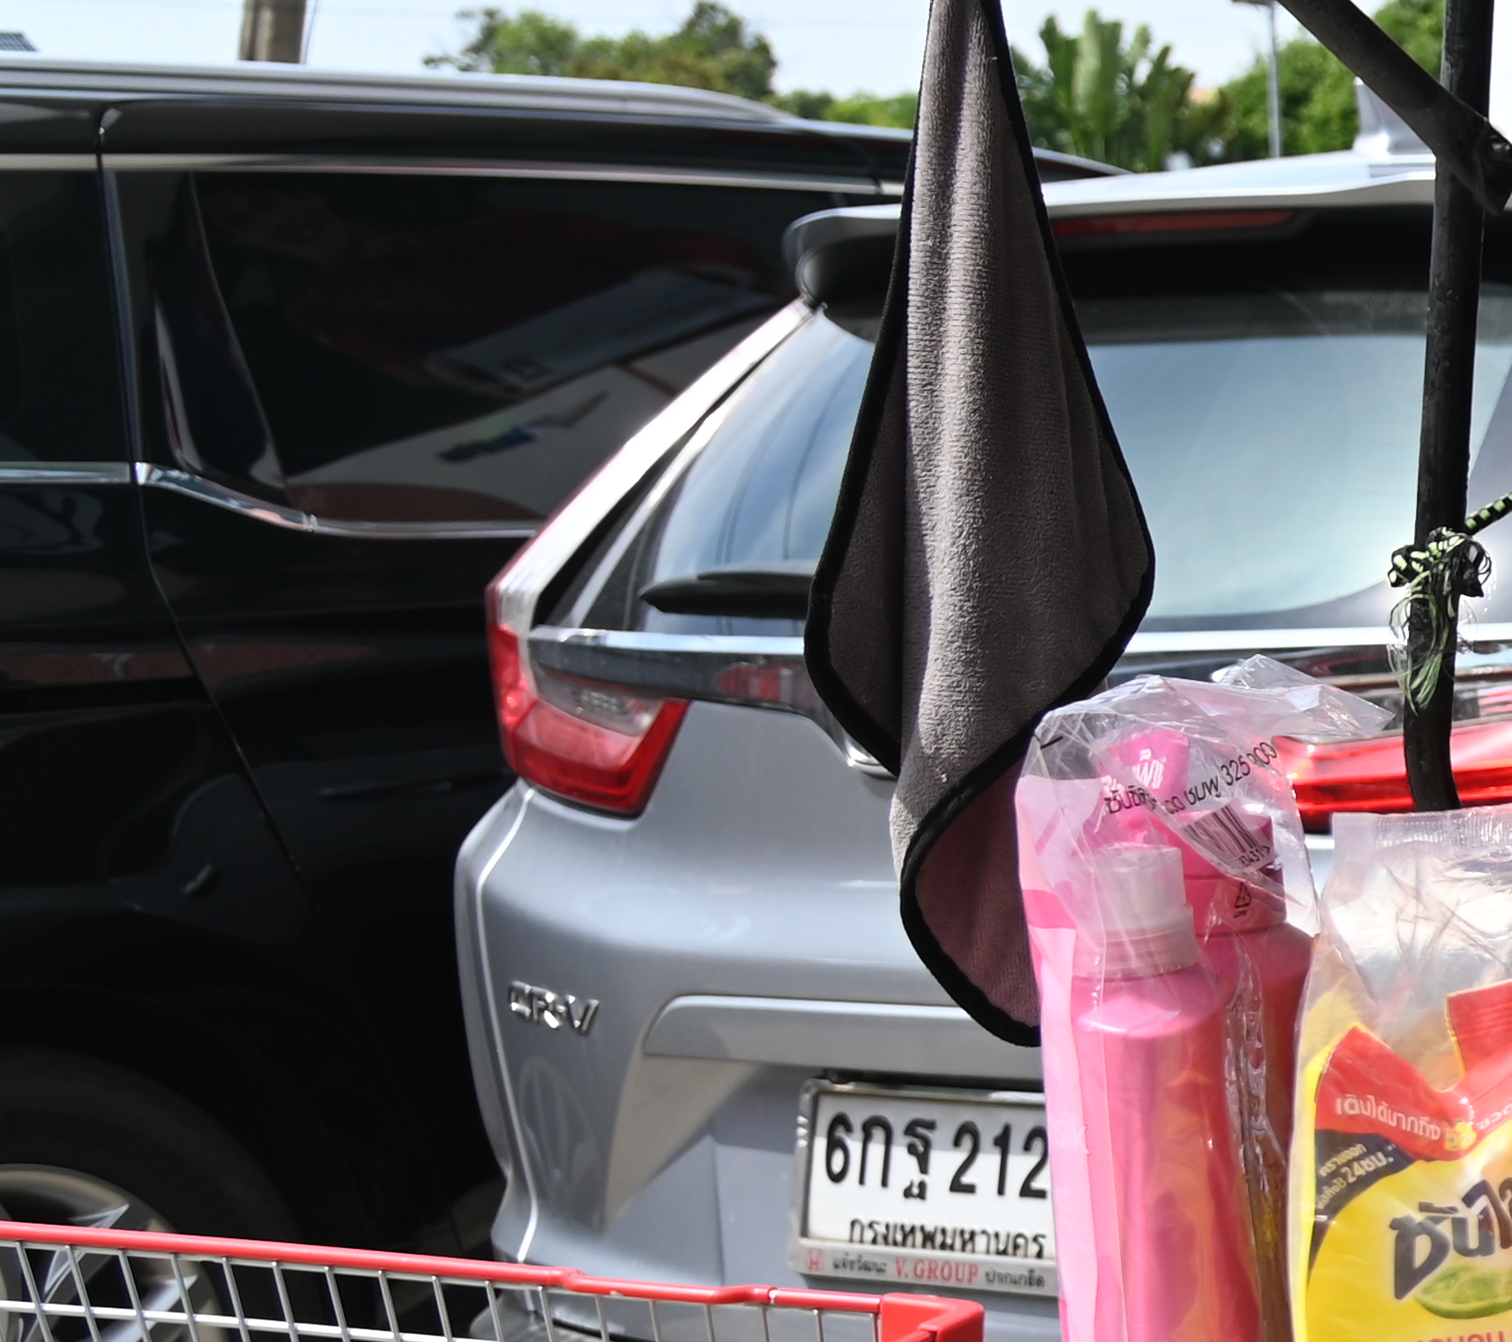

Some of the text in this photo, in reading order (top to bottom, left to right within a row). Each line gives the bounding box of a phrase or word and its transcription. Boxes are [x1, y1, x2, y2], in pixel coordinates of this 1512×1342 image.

[826, 1112, 936, 1200] 6กฐ
[850, 1219, 1046, 1259] กรุงเทพมหานคร
[914, 1259, 979, 1284] GROUP
